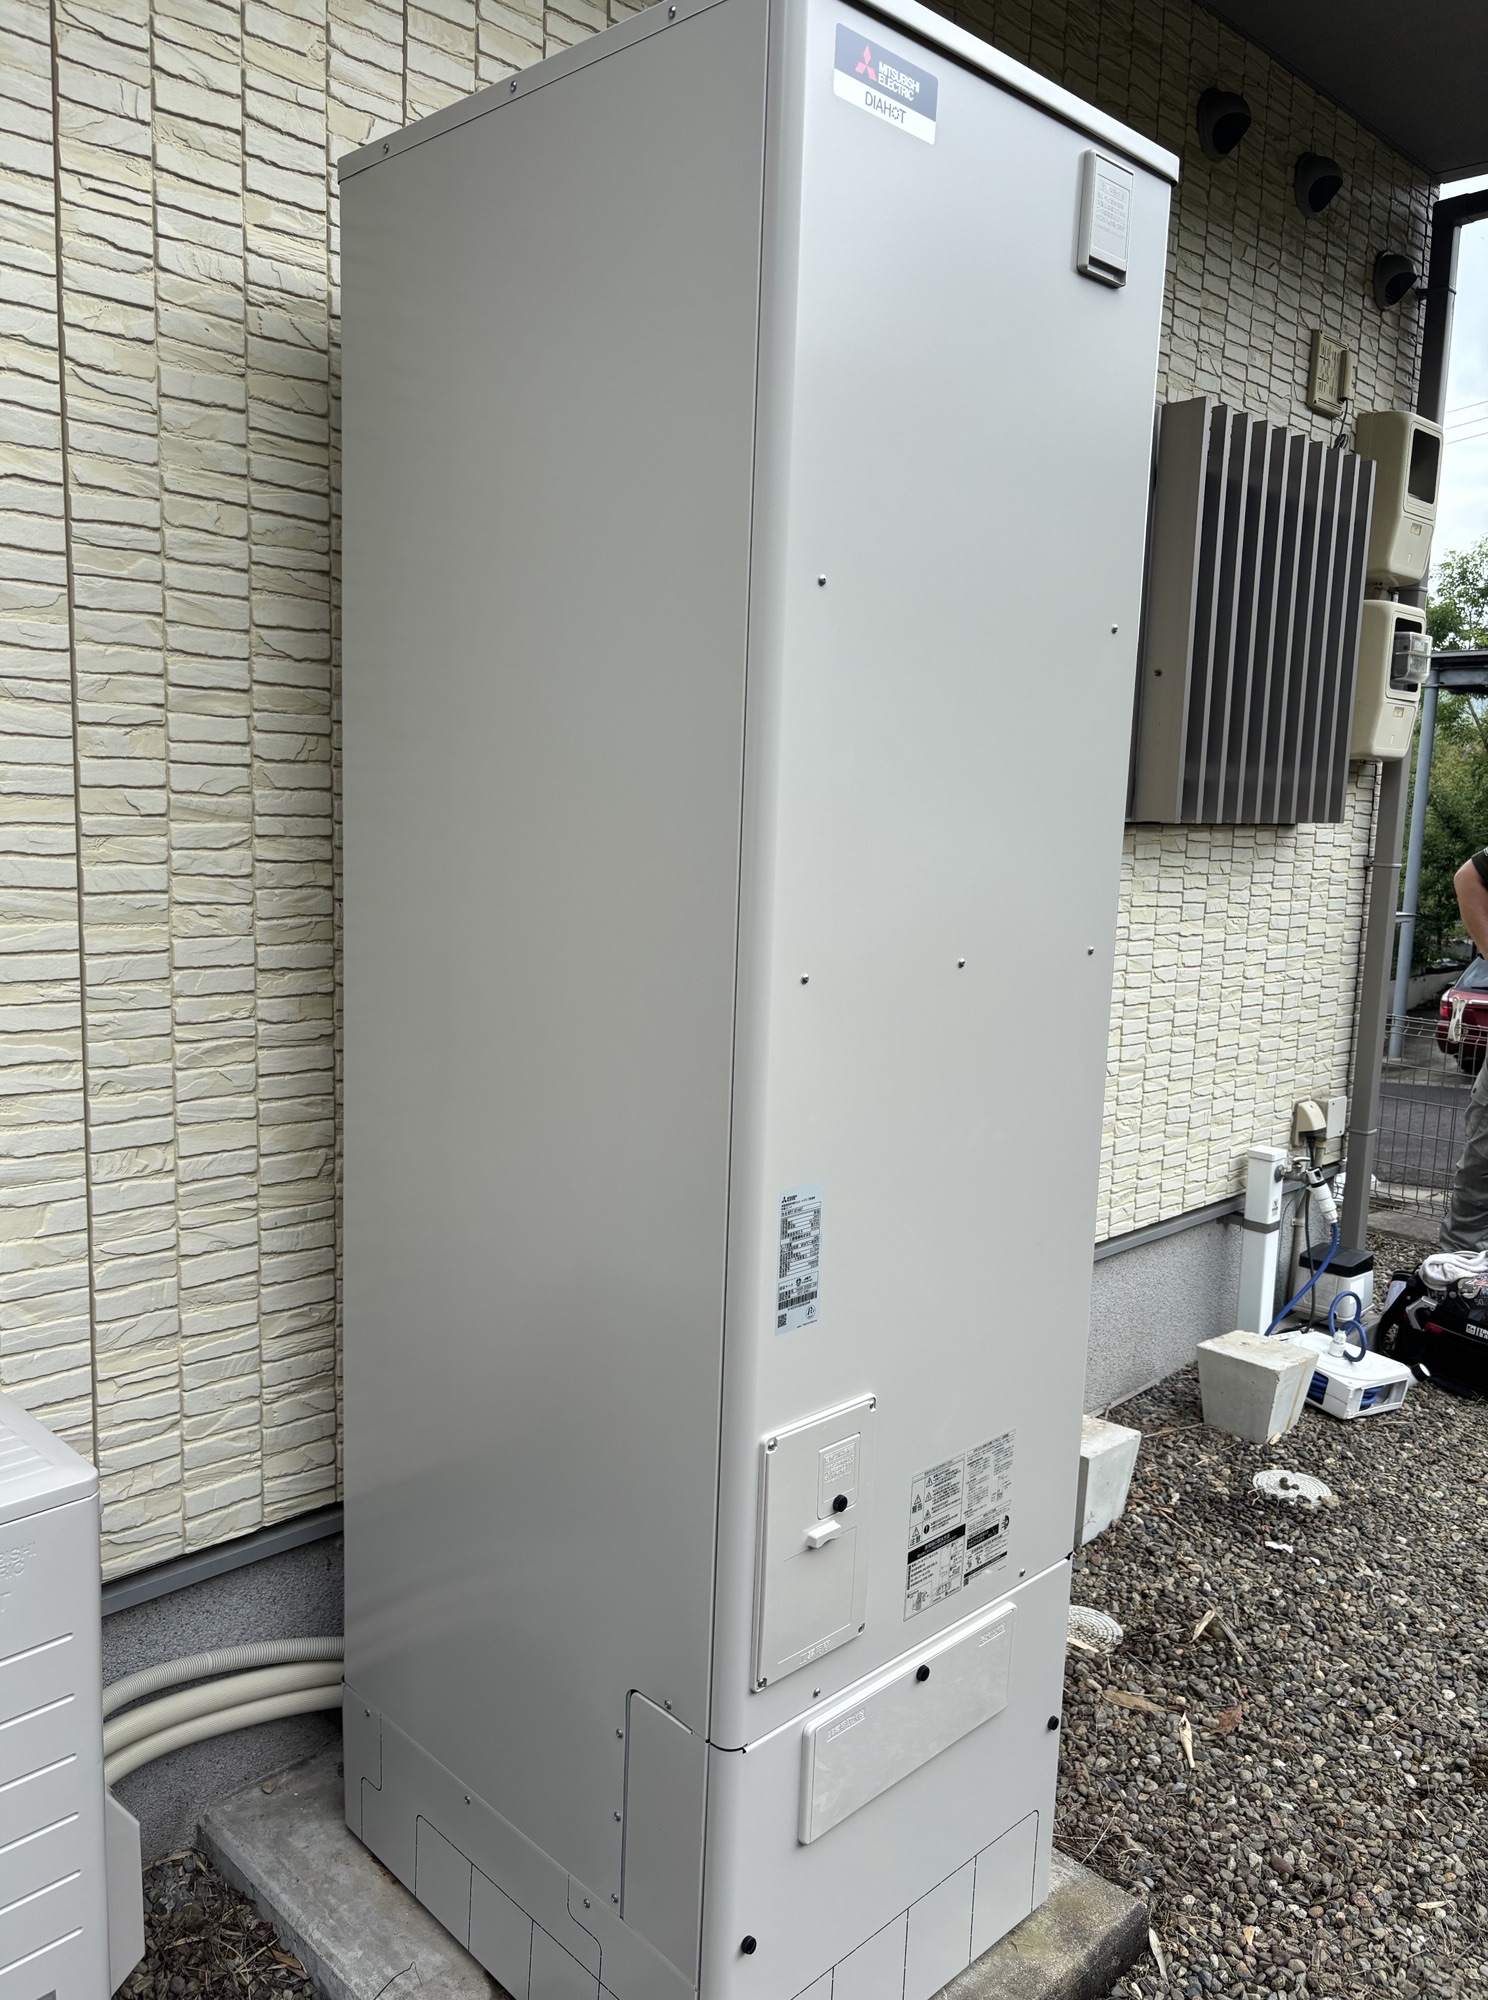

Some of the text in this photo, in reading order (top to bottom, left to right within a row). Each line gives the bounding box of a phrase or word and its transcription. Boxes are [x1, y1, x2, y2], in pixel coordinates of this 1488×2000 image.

[878, 61, 920, 94] MITSUBISHI
[878, 72, 914, 102] ELECTRIC
[865, 91, 907, 124] DIAHOT
